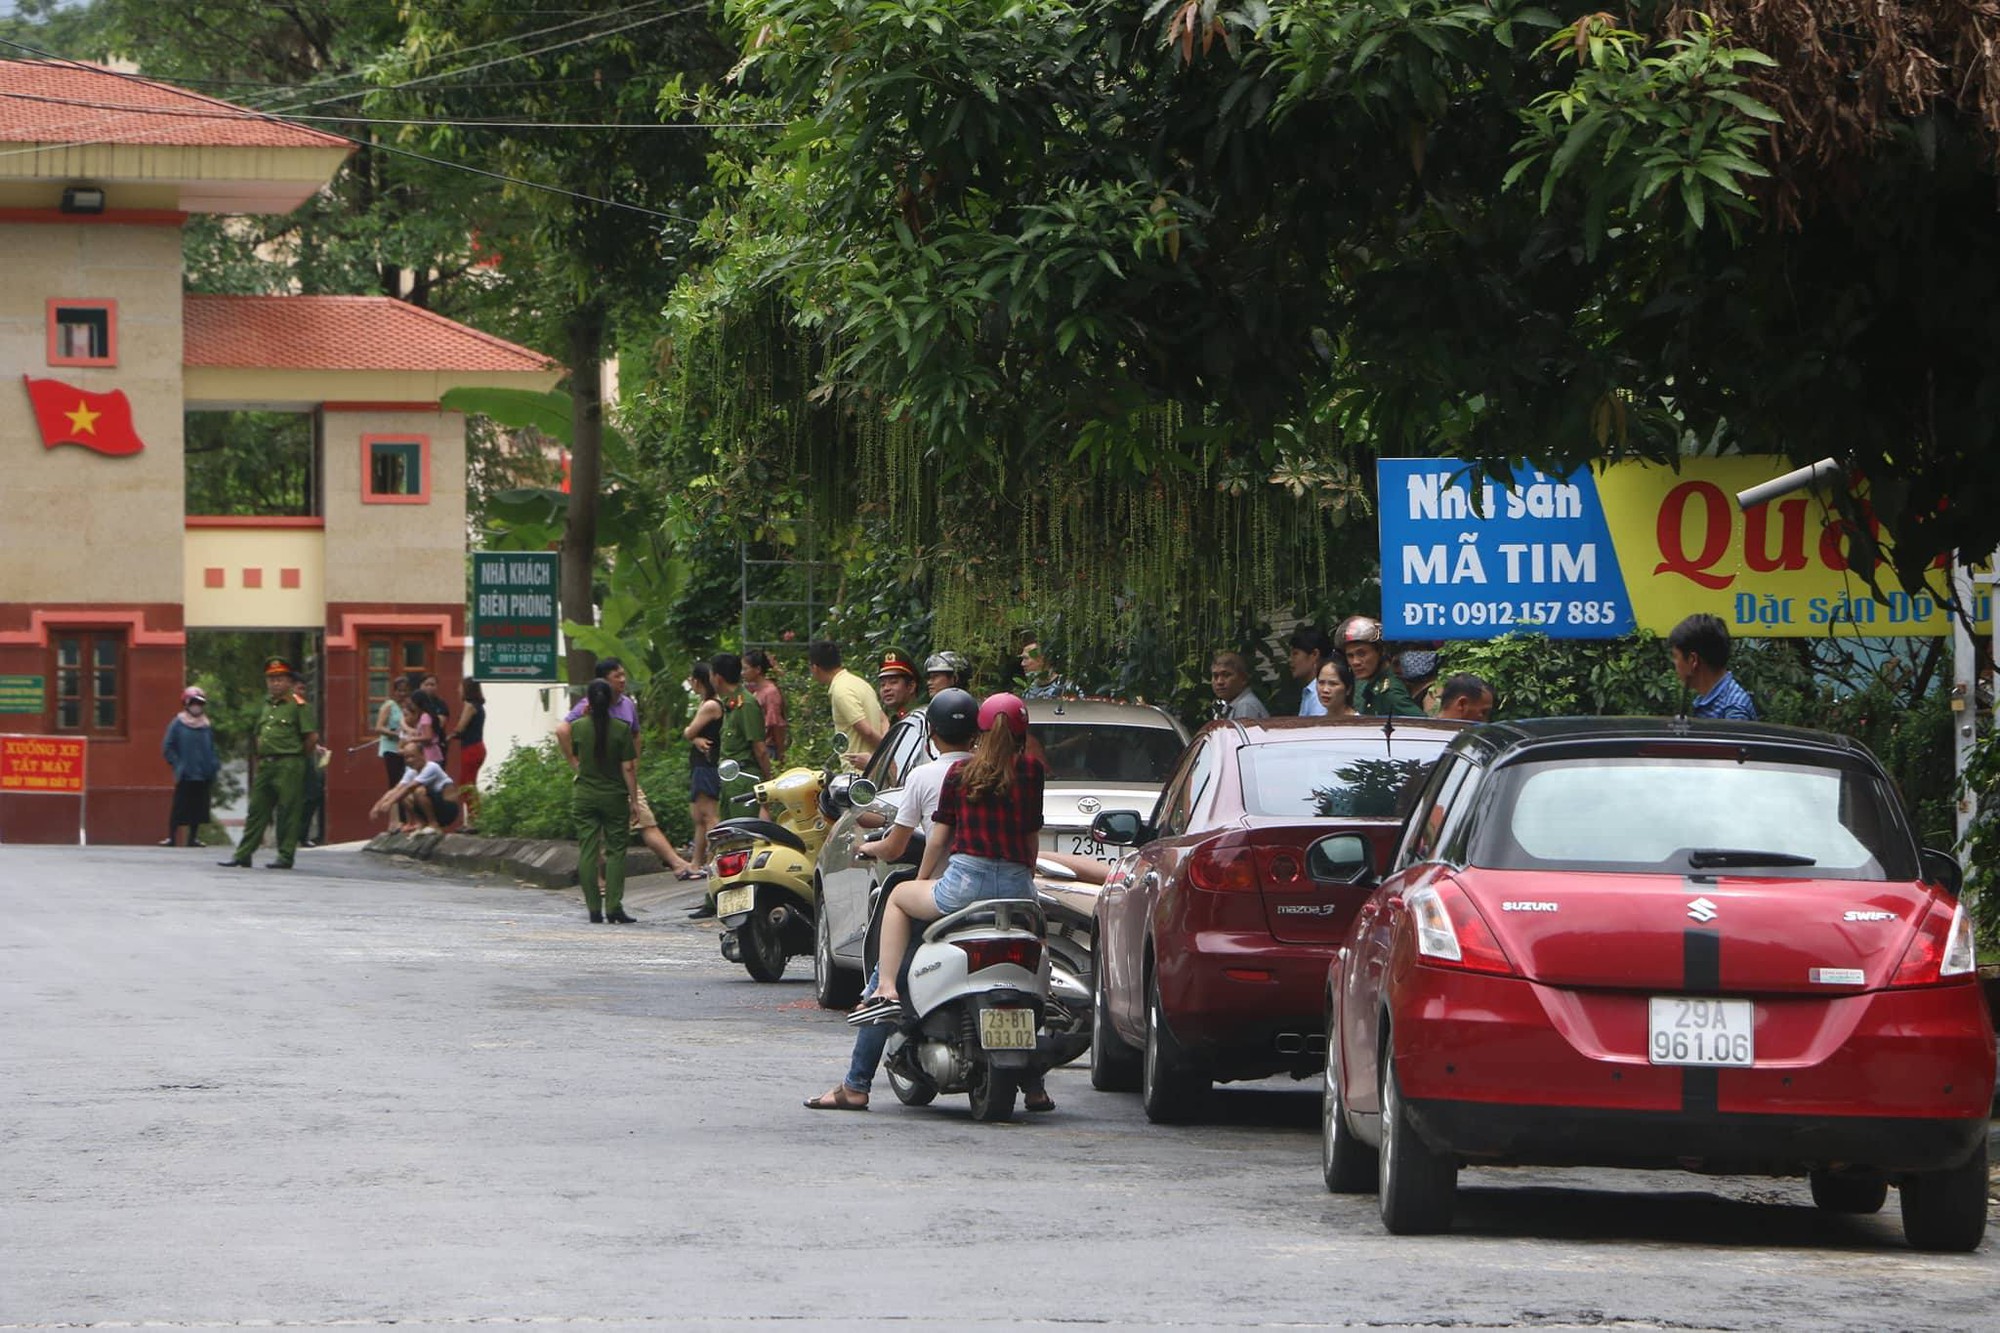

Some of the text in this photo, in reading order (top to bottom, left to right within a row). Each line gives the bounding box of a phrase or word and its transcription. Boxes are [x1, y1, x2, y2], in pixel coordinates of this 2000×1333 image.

[481, 558, 551, 585] NHÀ KHÁCH
[1402, 532, 1597, 584] MÃ TIM
[479, 589, 508, 617] BIÊN
[1403, 601, 1616, 626] ĐT: 0912 157 885
[1734, 592, 1797, 629] Đặc
[60, 744, 80, 757] XE
[1071, 836, 1106, 856] 23A
[1502, 901, 1559, 912] SUZUKI
[1674, 1000, 1727, 1029] 29A
[1654, 1031, 1749, 1062] 961.06
